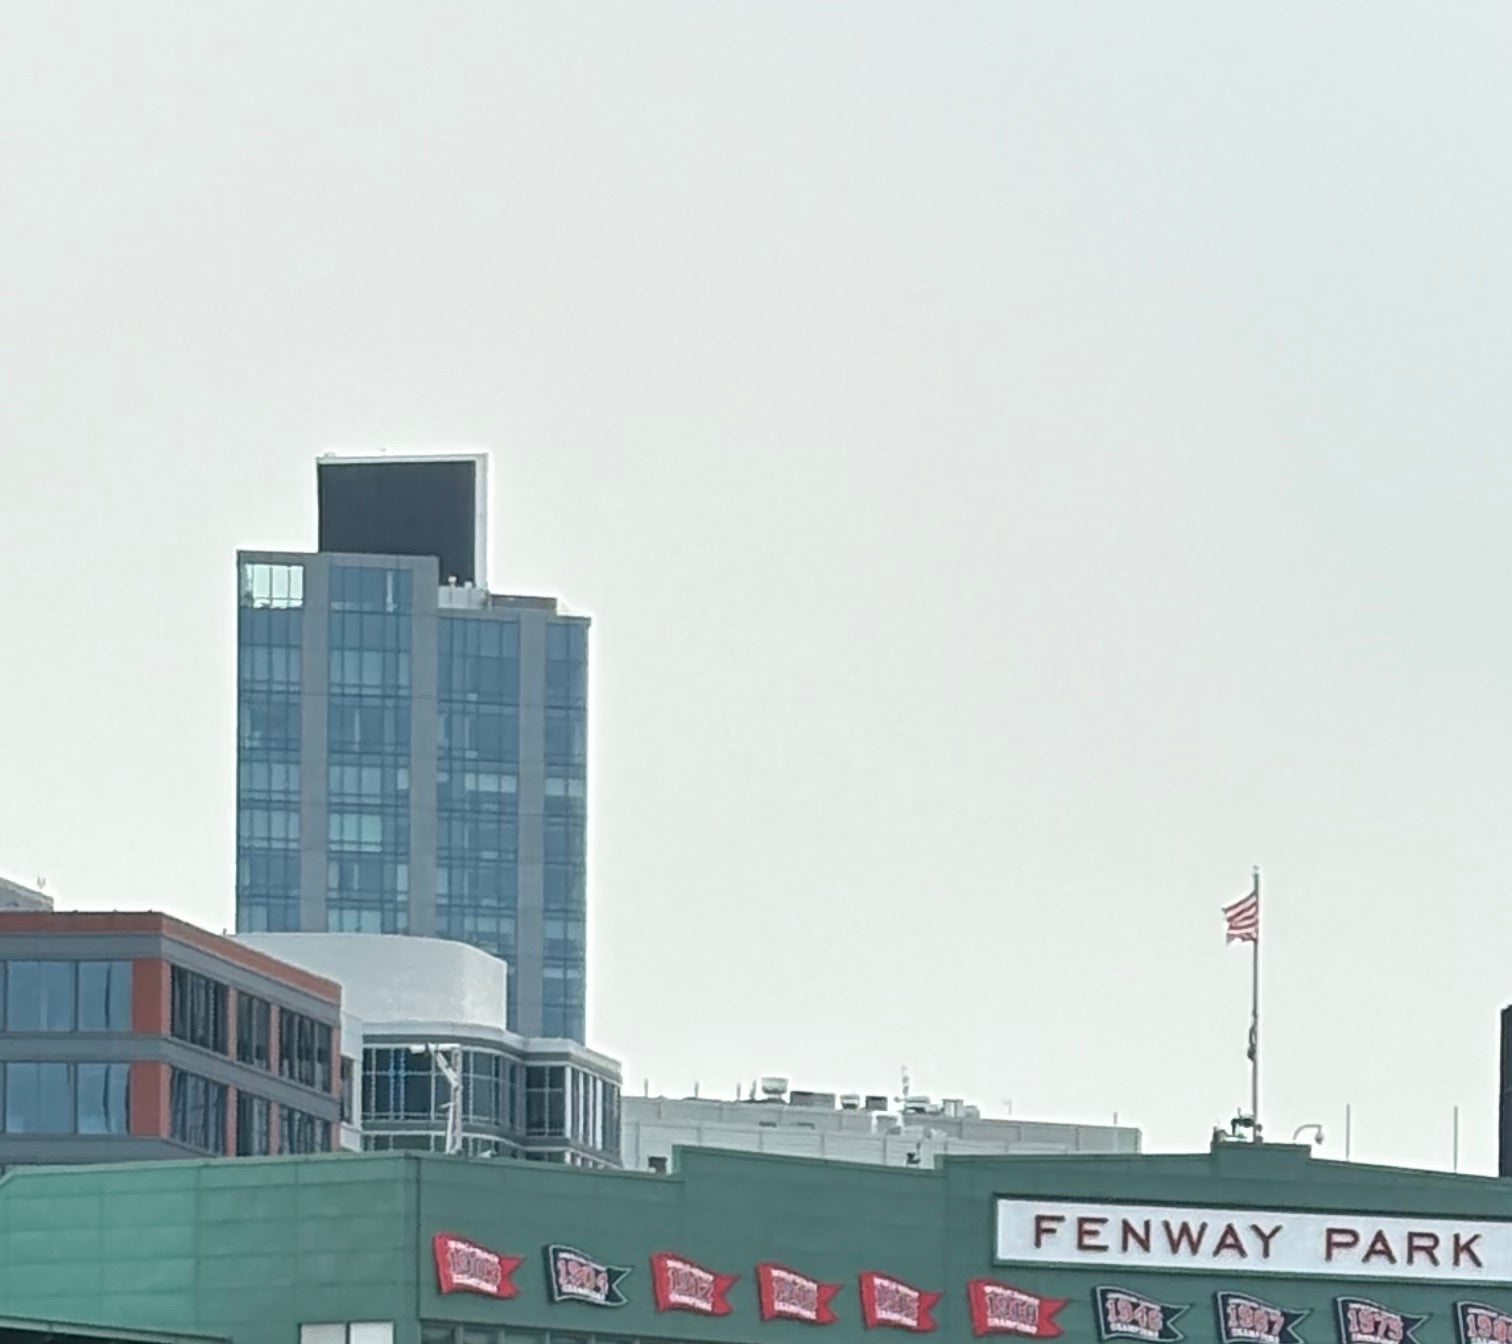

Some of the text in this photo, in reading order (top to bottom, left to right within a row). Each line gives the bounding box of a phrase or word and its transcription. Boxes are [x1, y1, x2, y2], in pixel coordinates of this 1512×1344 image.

[1033, 1214, 1485, 1268] FENWAY PARK
[1105, 1298, 1163, 1331] 1946
[1347, 1308, 1403, 1341] 1975
